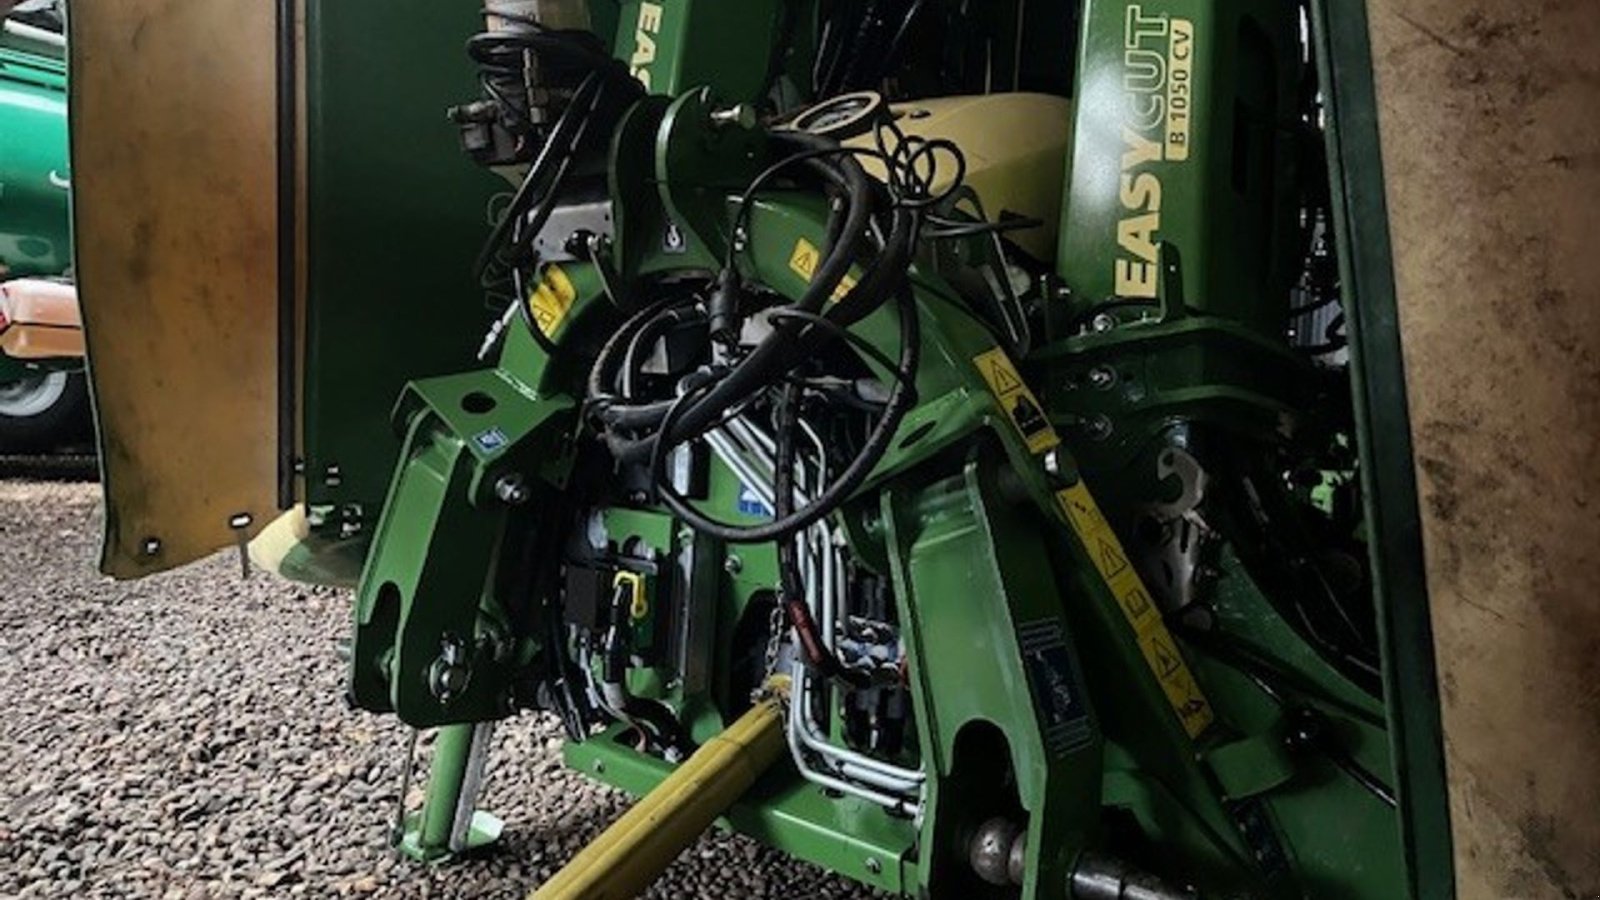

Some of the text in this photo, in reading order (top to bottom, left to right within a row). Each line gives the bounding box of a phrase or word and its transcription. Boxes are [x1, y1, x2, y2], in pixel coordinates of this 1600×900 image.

[1171, 29, 1191, 146] B 1050 CV
